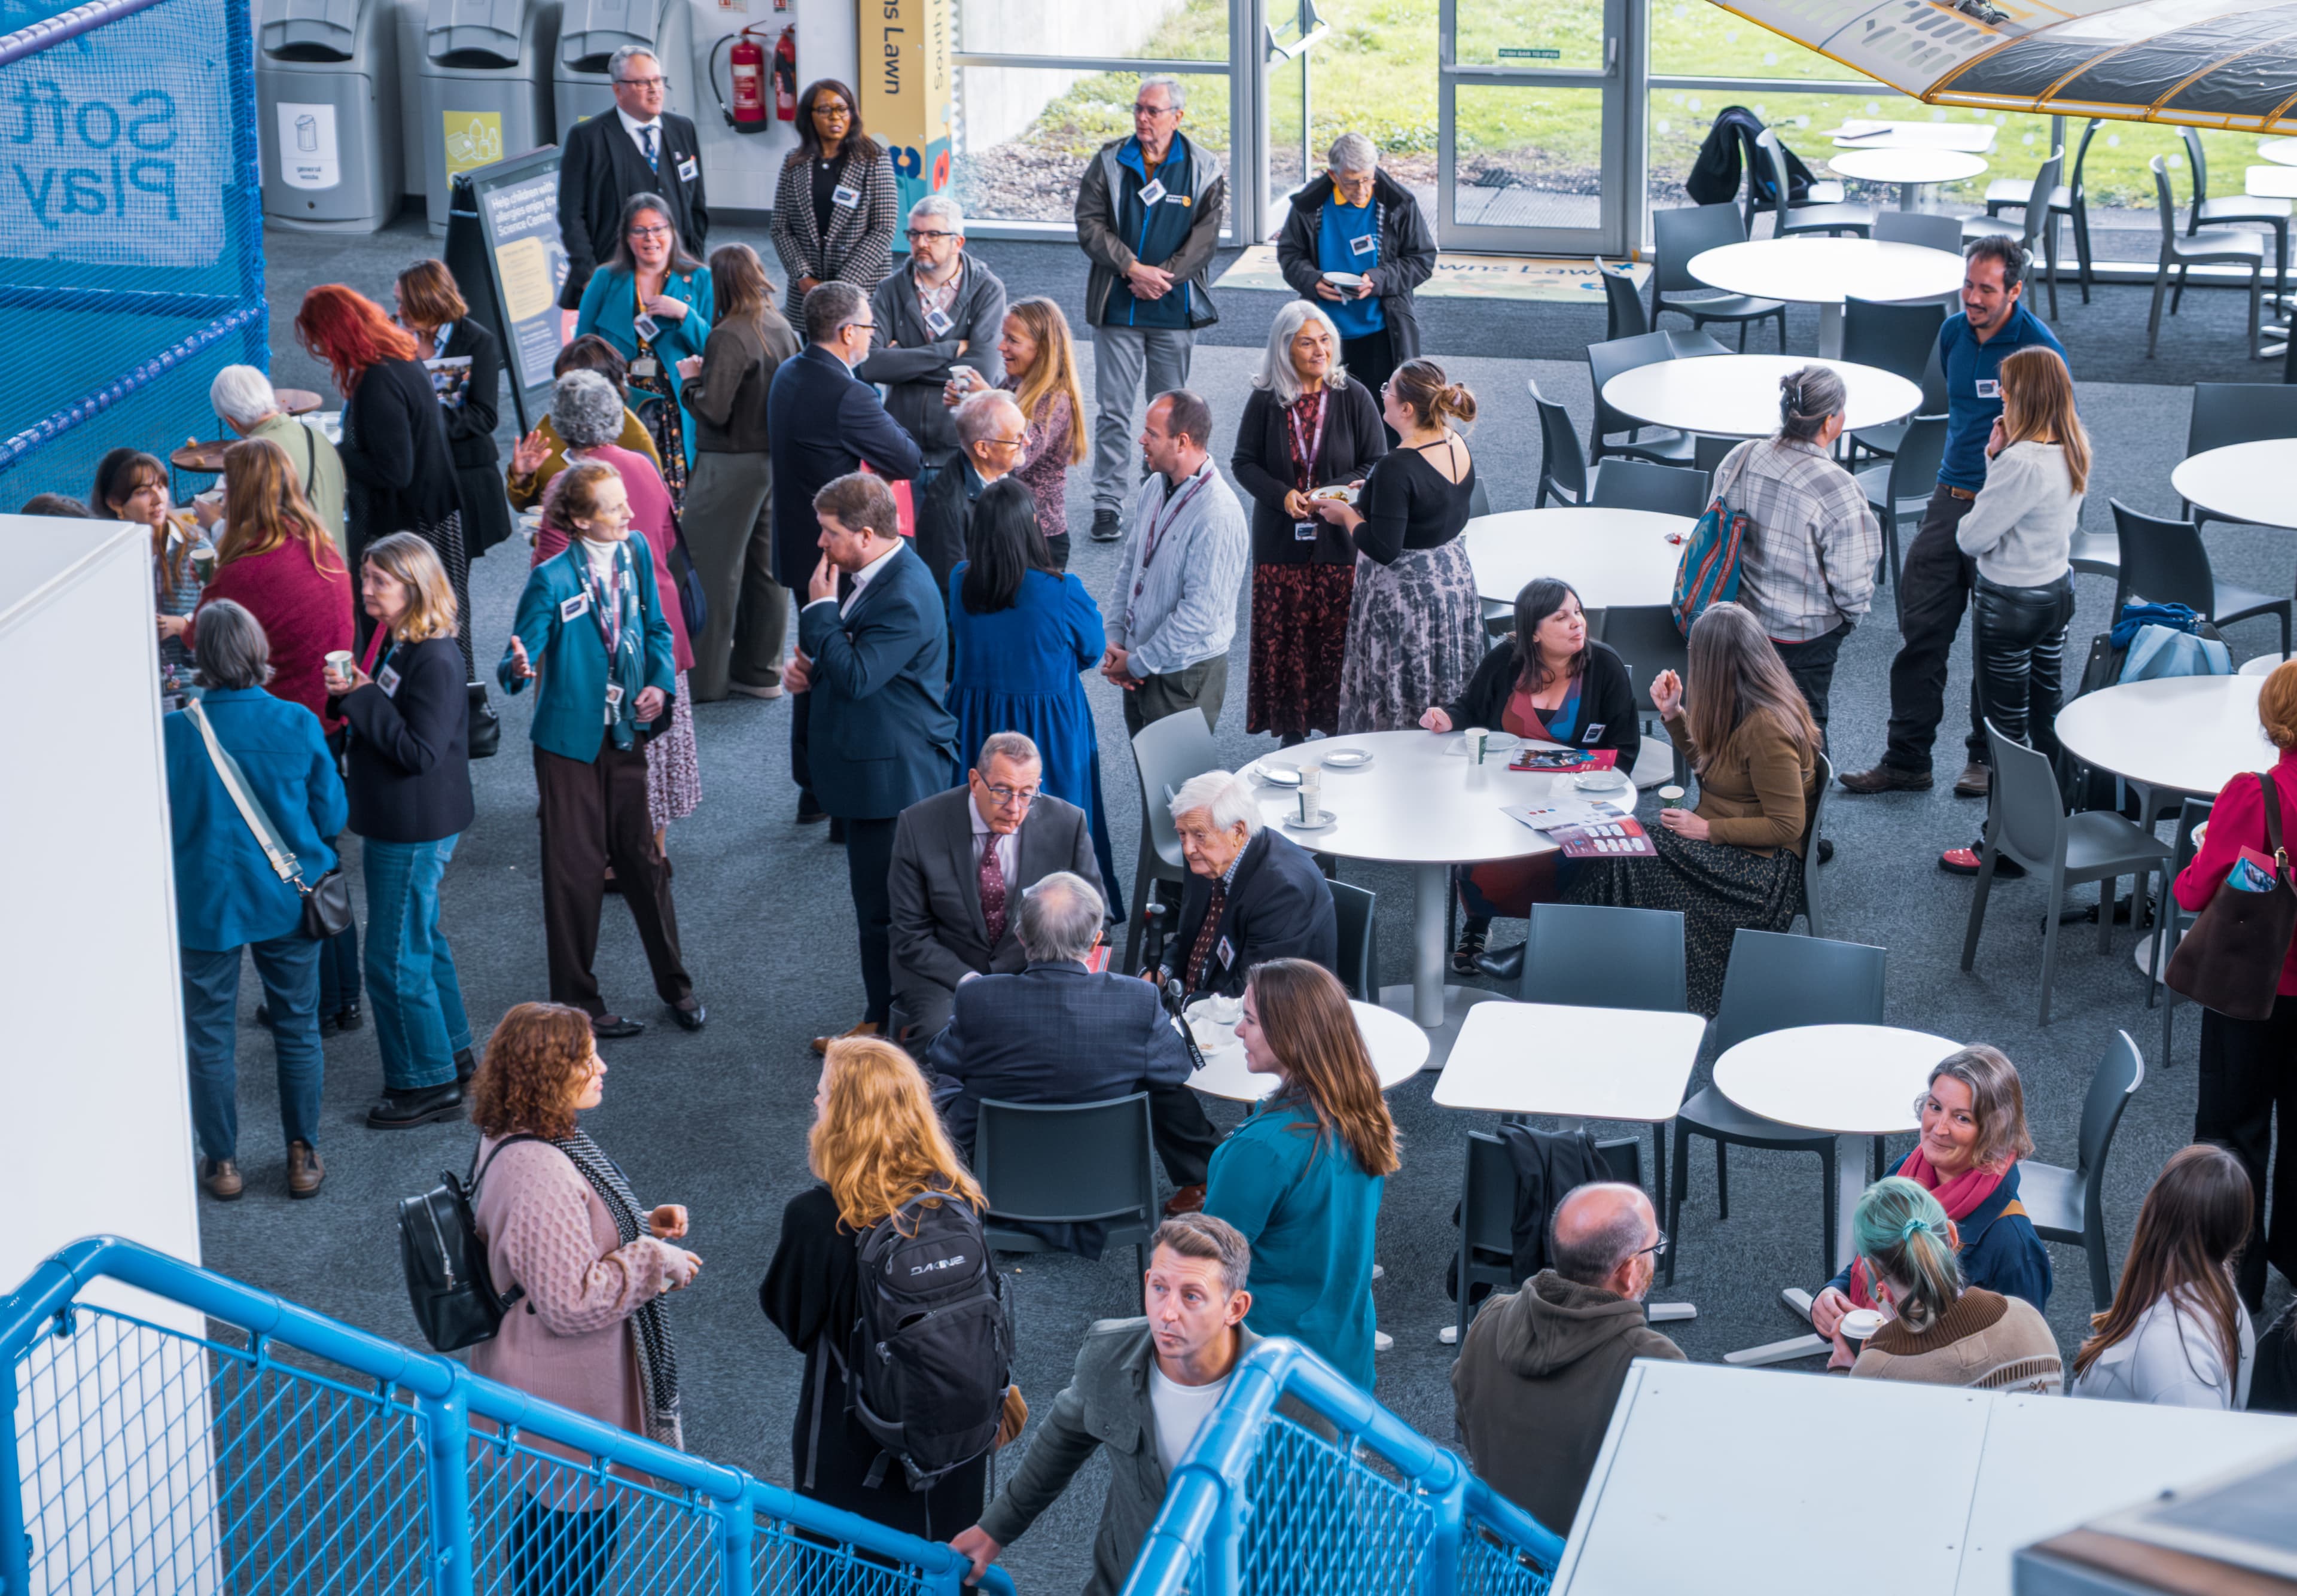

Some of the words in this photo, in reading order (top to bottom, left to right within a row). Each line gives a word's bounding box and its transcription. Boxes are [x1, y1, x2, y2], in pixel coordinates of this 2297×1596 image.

[884, 26, 904, 95] Lawn
[933, 12, 943, 90] South
[491, 196, 510, 209] Help
[510, 188, 538, 204] children
[538, 181, 555, 194] with
[495, 205, 526, 224] allergies
[525, 199, 545, 214] enjoy
[497, 221, 527, 237] Science
[526, 212, 553, 227] Centre
[910, 1255, 967, 1276] DAKINE
